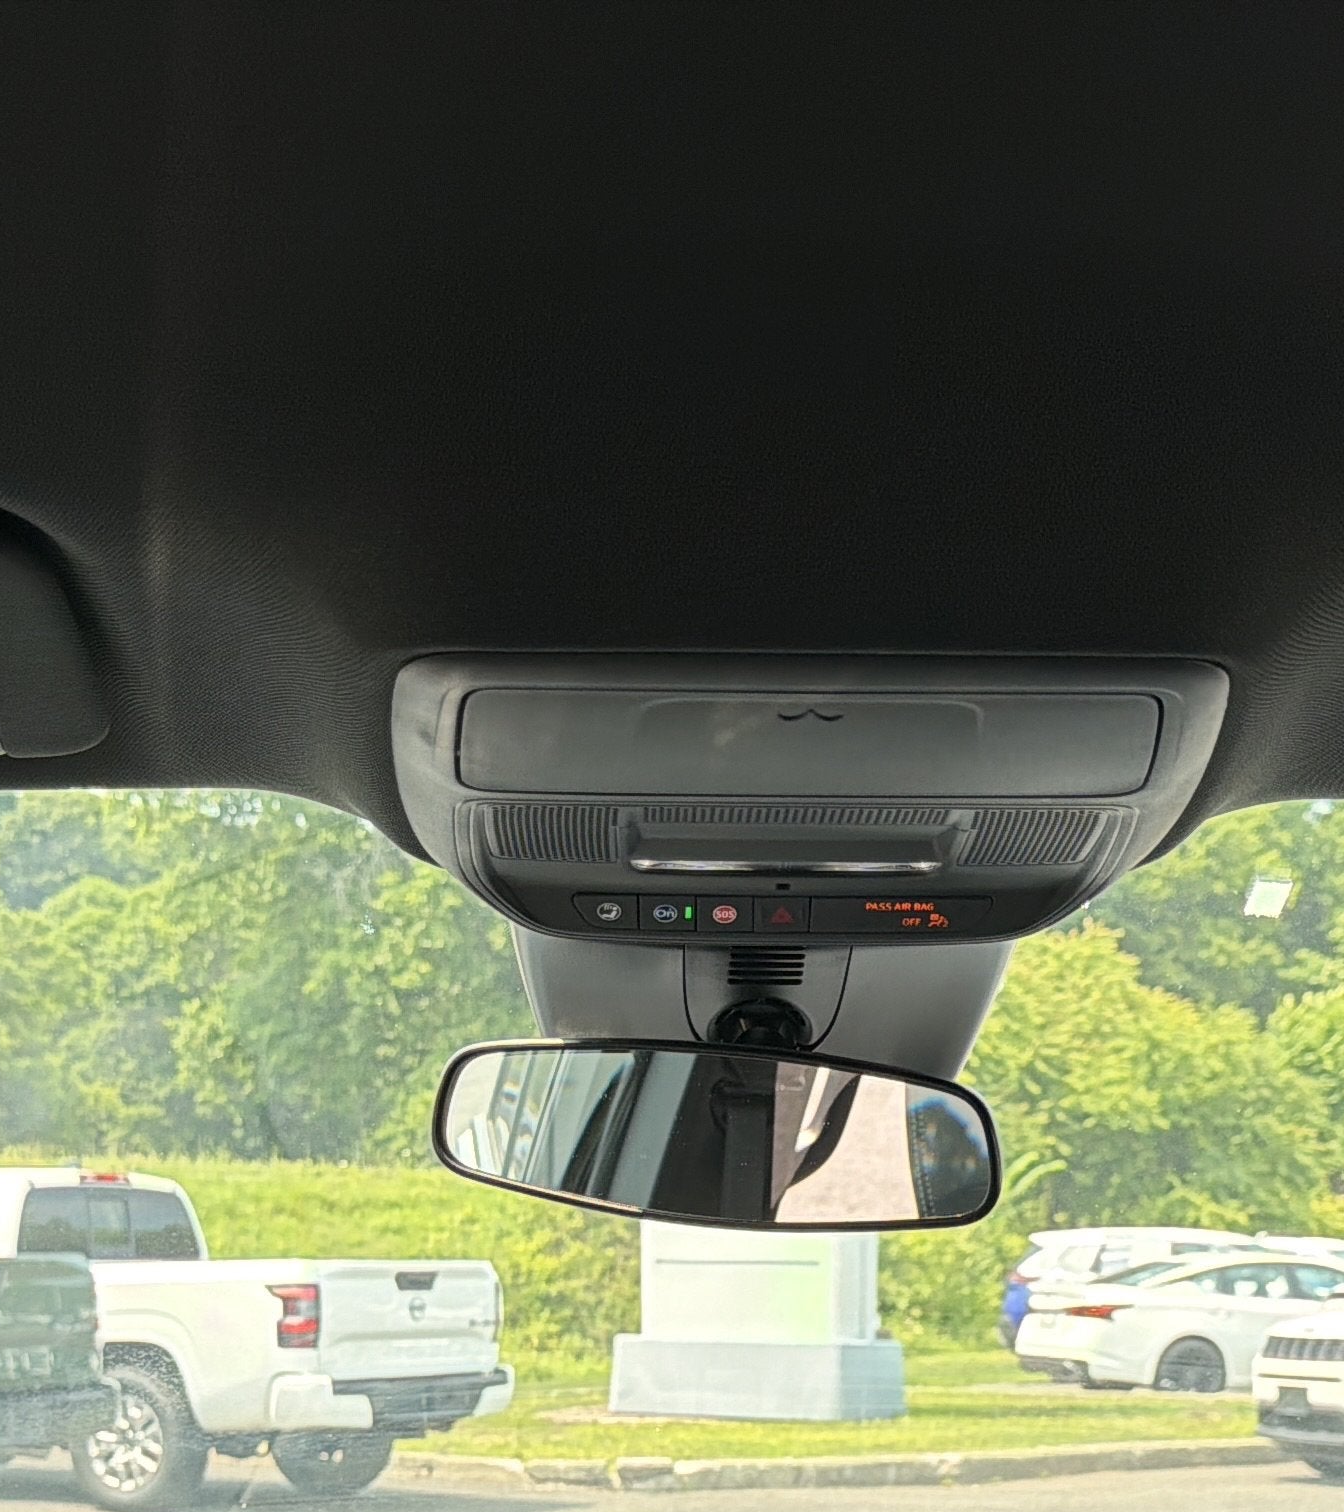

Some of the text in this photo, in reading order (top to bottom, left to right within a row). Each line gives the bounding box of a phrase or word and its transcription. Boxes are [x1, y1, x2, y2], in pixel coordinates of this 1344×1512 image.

[865, 902, 935, 913] PASS AIR BAG
[714, 907, 736, 920] SOS
[901, 917, 921, 928] OFF
